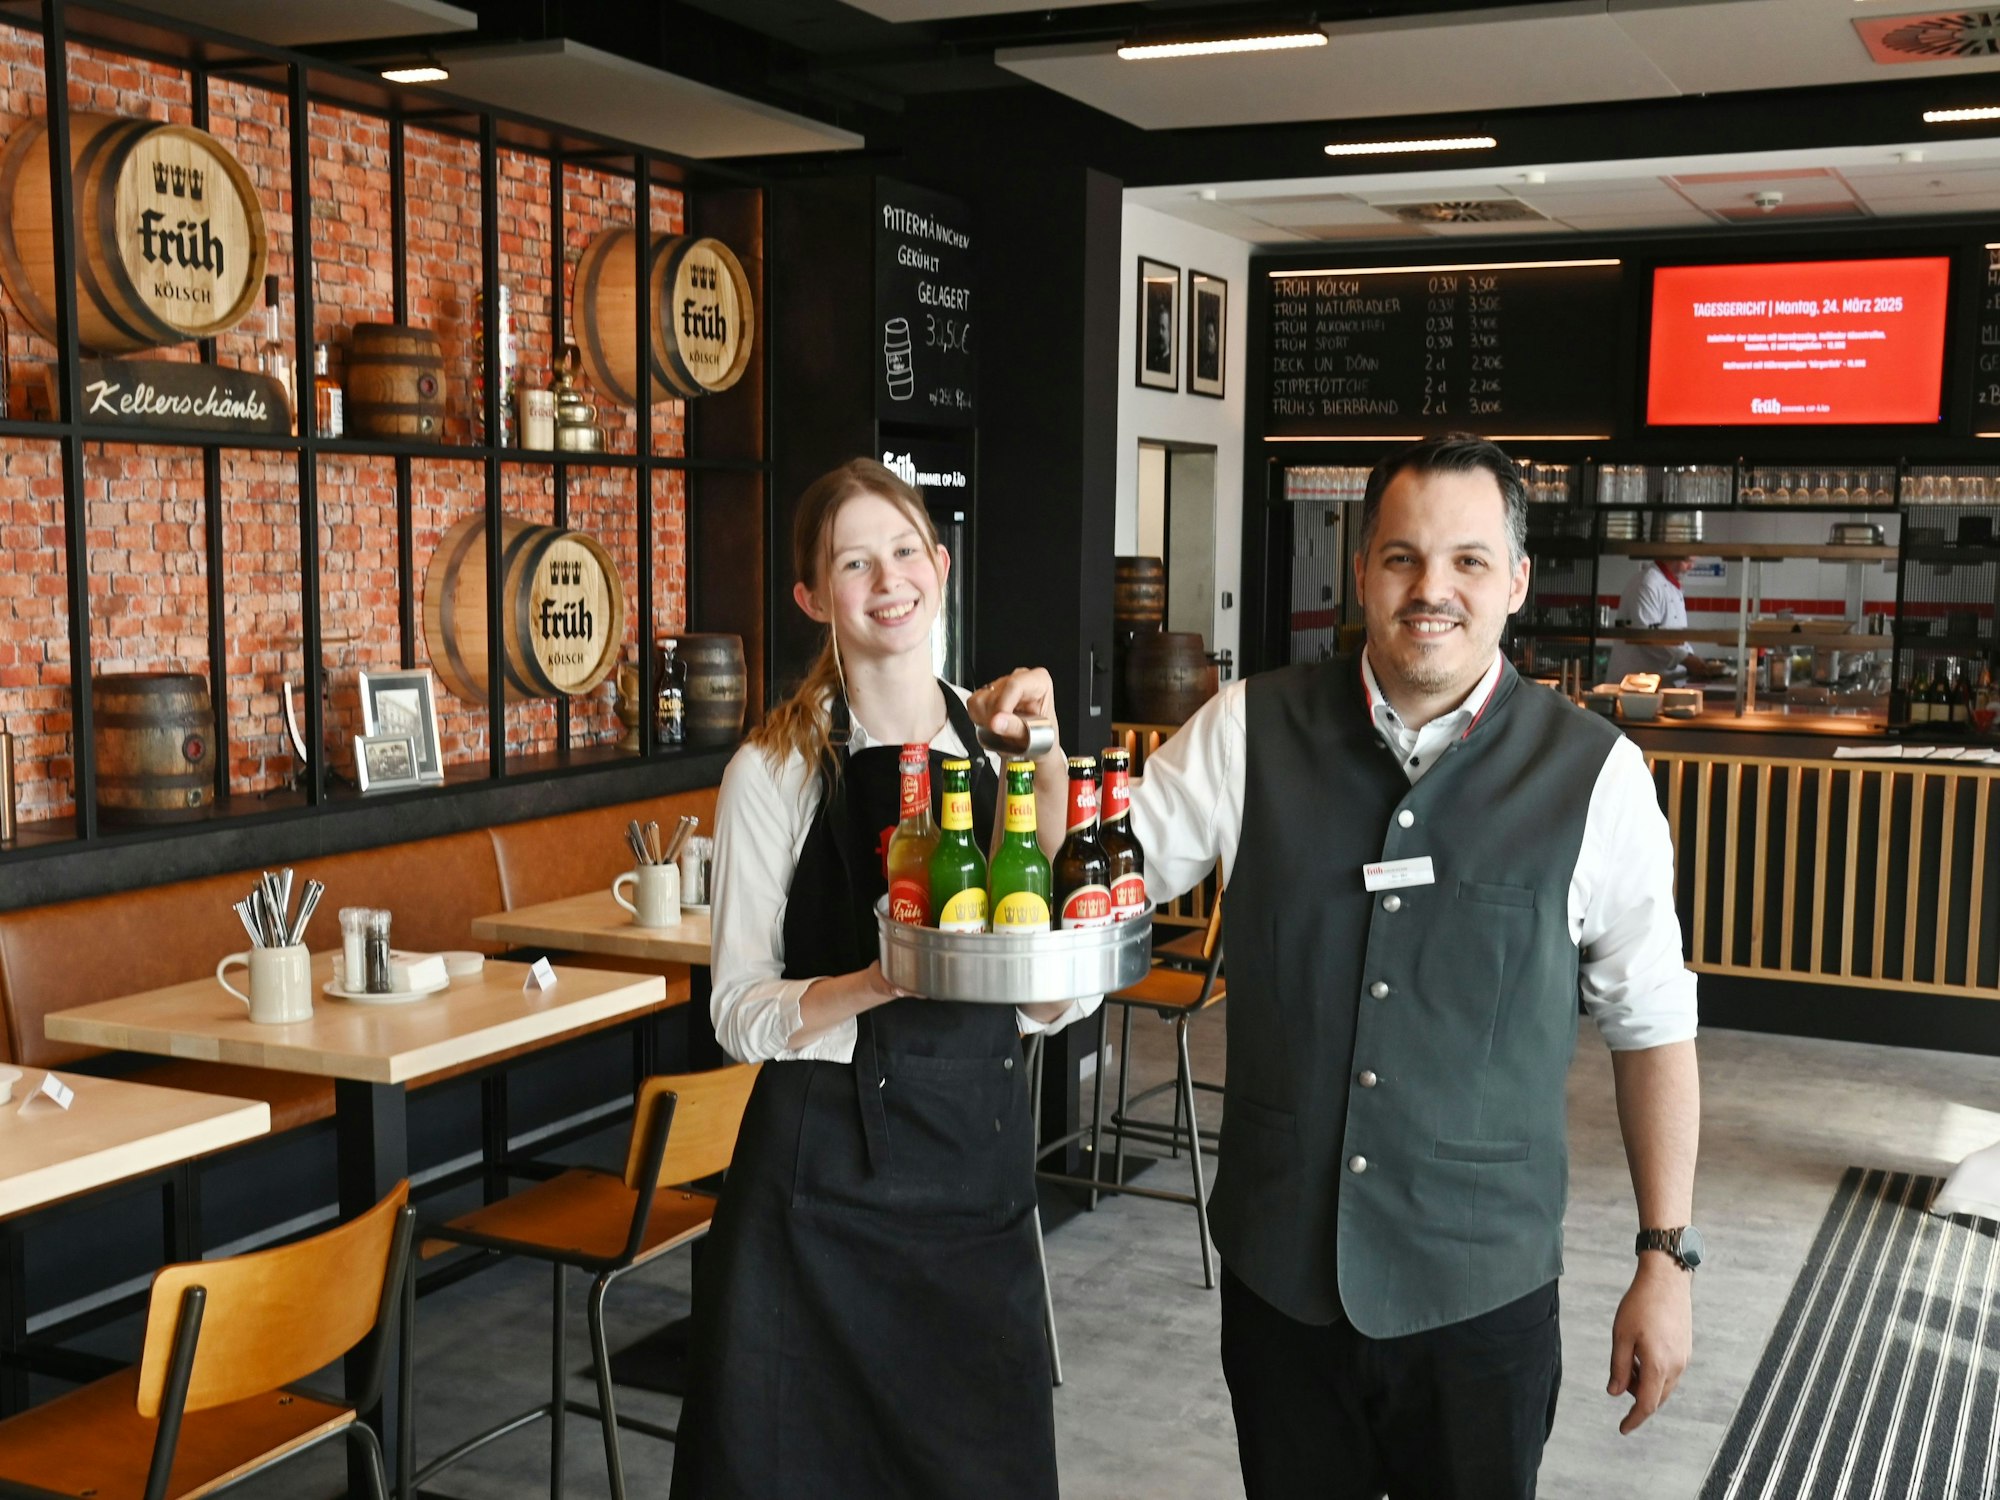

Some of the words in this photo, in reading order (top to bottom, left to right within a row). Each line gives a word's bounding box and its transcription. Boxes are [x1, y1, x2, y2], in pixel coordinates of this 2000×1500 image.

[137, 208, 224, 280] früh
[897, 244, 940, 273] GEKÜHLT
[154, 280, 211, 304] KÖLSCH
[918, 280, 970, 312] GELAGERT
[1274, 278, 1310, 297] FRÜH
[1316, 277, 1360, 297] KÖLSCH
[1273, 301, 1308, 317] FRÜH
[1316, 297, 1401, 316] NATURRADLER
[1693, 301, 1766, 318] TAGESGERICHT
[1774, 300, 1821, 318] Montag,
[1822, 299, 1840, 315] 24.
[1843, 297, 1871, 314] März
[1873, 296, 1904, 313] 2025
[681, 298, 726, 346] früh
[1274, 319, 1308, 335] FRÜH
[1274, 337, 1307, 352] FRÜH
[1315, 336, 1349, 351] SPORT
[689, 349, 720, 365] KÖLSCH
[1273, 356, 1305, 373] DECK
[1314, 356, 1333, 372] UN
[1345, 353, 1379, 372] DÖNN
[1425, 353, 1433, 371] 2
[1425, 376, 1433, 393] 2
[86, 380, 268, 421] Kellerschänke
[1322, 397, 1399, 416] BIERBRAND
[1422, 394, 1432, 415] 2
[539, 597, 593, 643] früh
[548, 651, 584, 666] KÖLSCH
[893, 898, 923, 922] Früh
